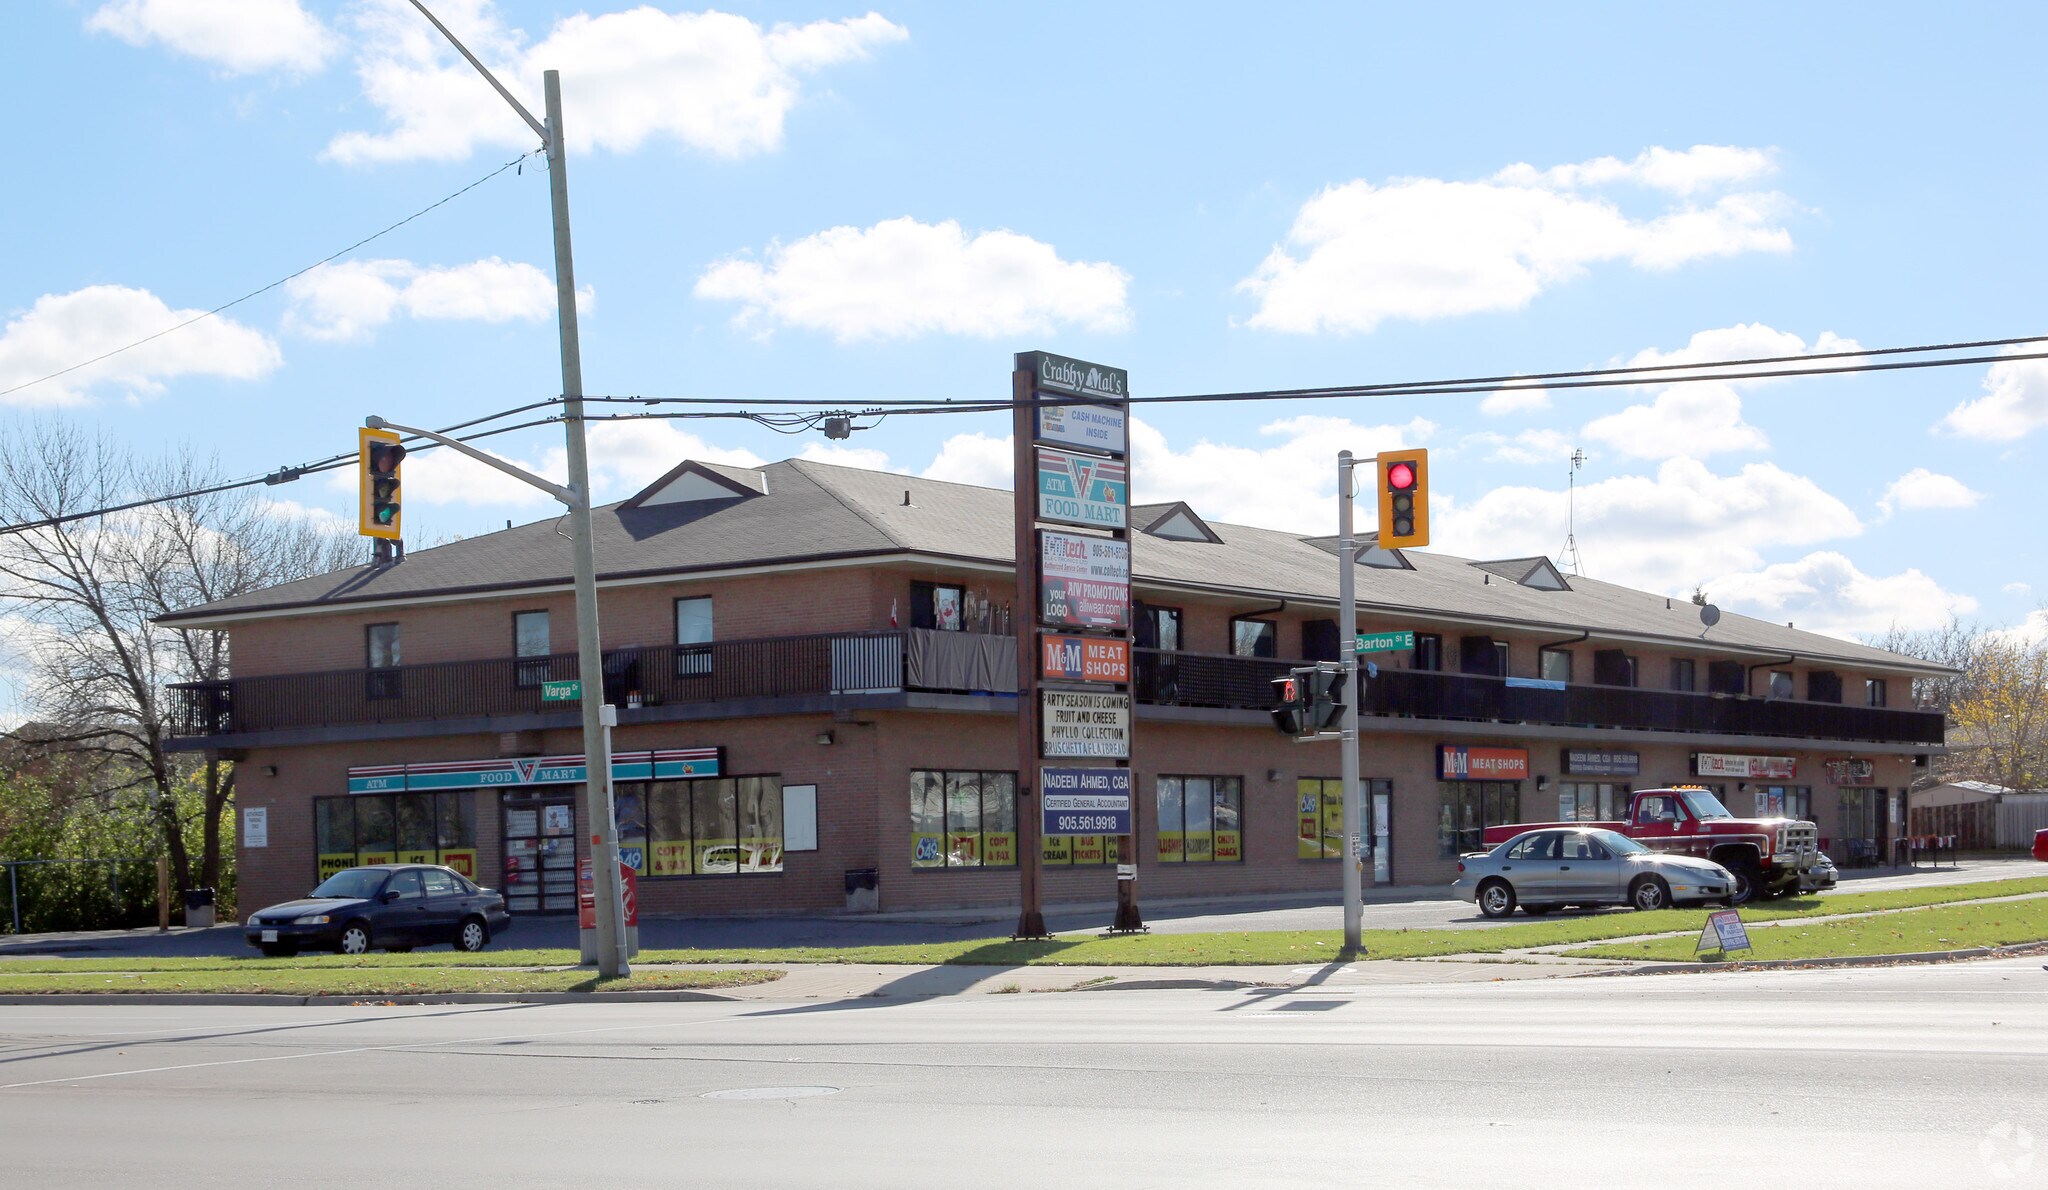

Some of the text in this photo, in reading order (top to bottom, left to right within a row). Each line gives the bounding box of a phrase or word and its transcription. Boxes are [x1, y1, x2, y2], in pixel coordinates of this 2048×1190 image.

[1043, 356, 1084, 391] Crabby
[1072, 411, 1090, 422] CASH
[1092, 414, 1122, 428] MACHINE
[1086, 427, 1108, 439] INSIDE
[1046, 478, 1066, 492] ATM
[1045, 498, 1120, 522] FOOD MART
[1050, 589, 1066, 601] your
[1083, 584, 1128, 601] PROMOTIONS
[1046, 604, 1068, 618] LOGO
[1356, 638, 1393, 650] Barton
[1405, 634, 1412, 646] E
[1046, 643, 1082, 672] M&M
[1088, 645, 1122, 659] MEAT
[1086, 661, 1125, 676] SHOPS
[545, 686, 571, 699] Varga
[1102, 697, 1128, 710] COMING
[1056, 710, 1116, 724] FRUIT AND CHEESE
[1052, 726, 1124, 740] PHYLLO COLLECTION
[1444, 752, 1524, 773] M&M MEAT SHOPS
[366, 779, 387, 788] ATM
[480, 772, 512, 783] FOOD
[542, 770, 576, 780] MART
[1113, 776, 1128, 789] CGA
[1059, 816, 1116, 830] 905.561.9918
[990, 838, 1008, 846] COPY
[1081, 837, 1094, 846] BUS
[658, 846, 684, 856] COPY
[916, 838, 938, 860] 649
[996, 851, 1010, 860] FAX
[1043, 850, 1067, 860] CREAM
[1074, 850, 1100, 860] TICKETS
[322, 858, 354, 868] PHONE
